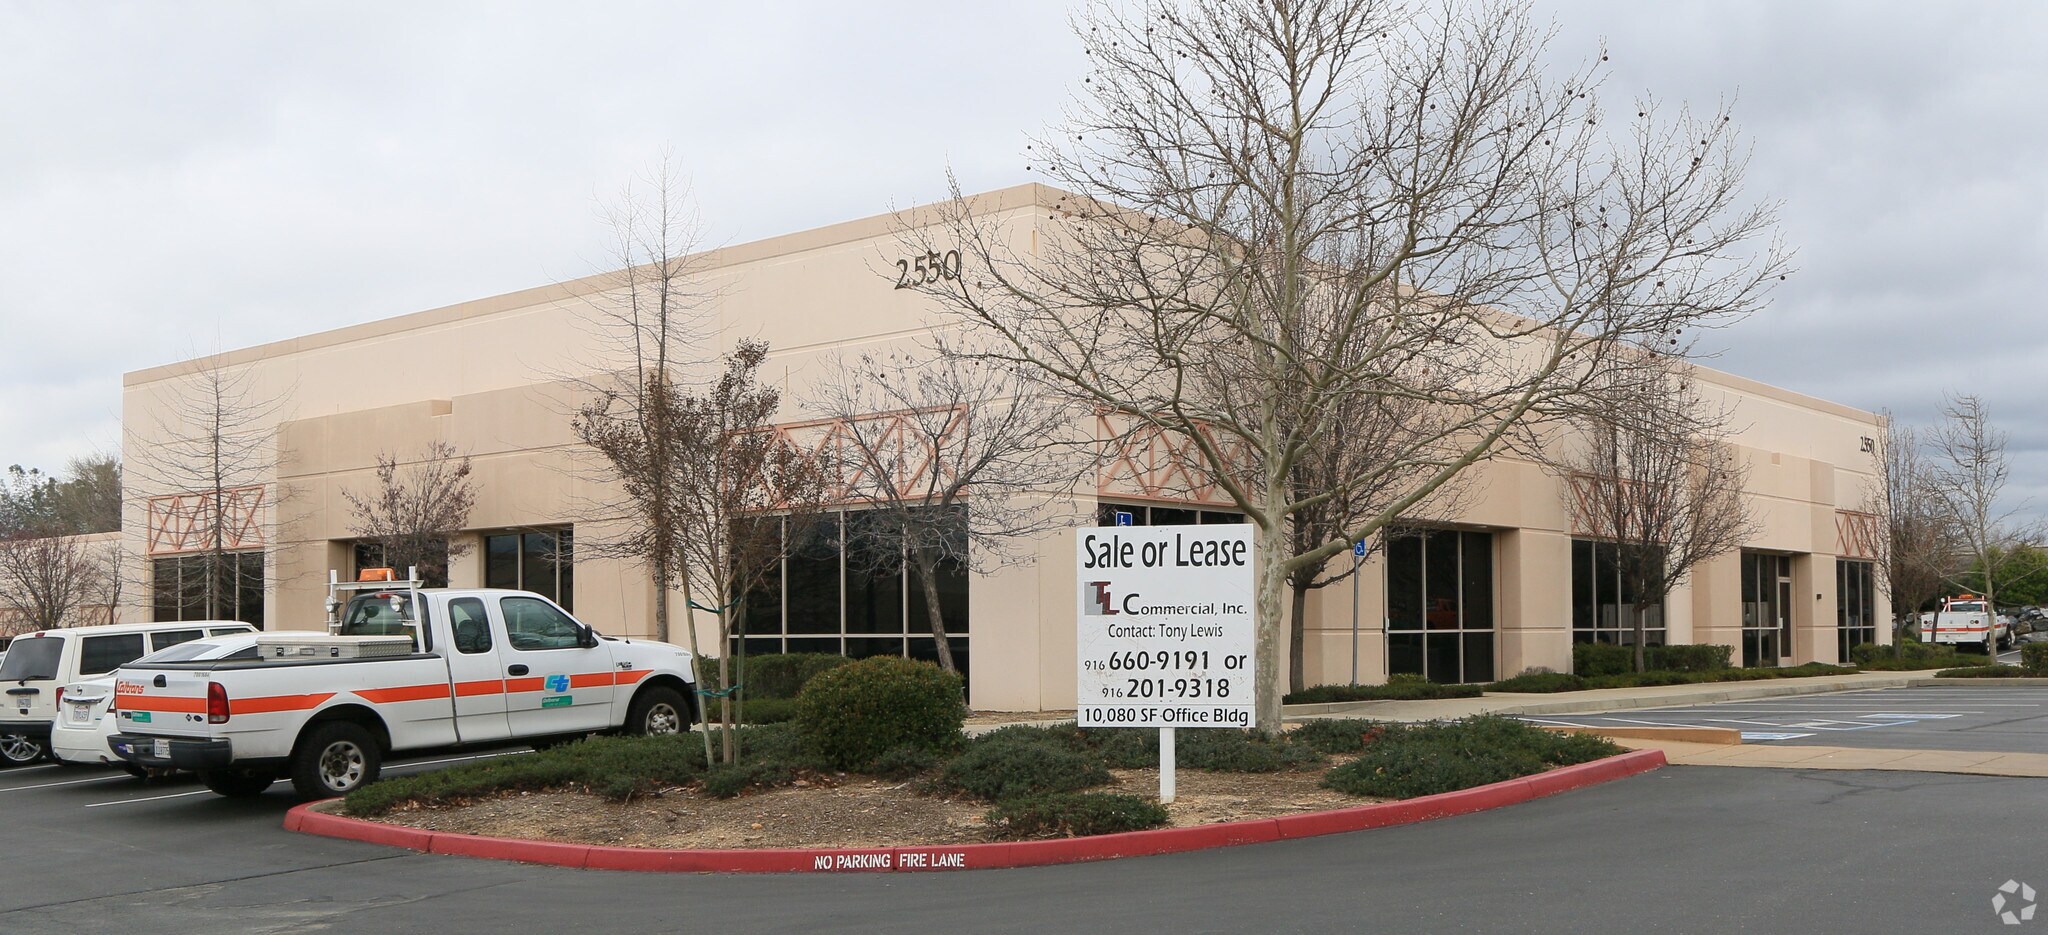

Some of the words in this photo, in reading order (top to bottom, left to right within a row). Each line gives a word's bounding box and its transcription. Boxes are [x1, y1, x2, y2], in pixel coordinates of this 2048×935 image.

[894, 249, 960, 290] 2550
[1084, 534, 1134, 569] Sale
[1141, 541, 1168, 568] or
[1176, 533, 1247, 567] Lease
[1122, 593, 1218, 616] Commercial,
[1222, 603, 1248, 615] Inc.
[1108, 624, 1156, 638] Contact:
[1159, 624, 1187, 641] Tony
[1190, 623, 1223, 637] Lewis
[1084, 660, 1105, 671] 916
[1109, 651, 1209, 670] 660-9191
[1224, 654, 1247, 670] or
[1102, 687, 1123, 698] 916
[1126, 678, 1230, 698] 201-9318
[1085, 708, 1136, 723] 10,080
[1140, 708, 1158, 722] SF
[1162, 708, 1209, 722] Office
[1213, 708, 1249, 726] Bldg
[814, 855, 833, 870] NO
[836, 853, 891, 869] PARKING
[899, 853, 928, 868] FIRE
[931, 853, 966, 868] LANE
